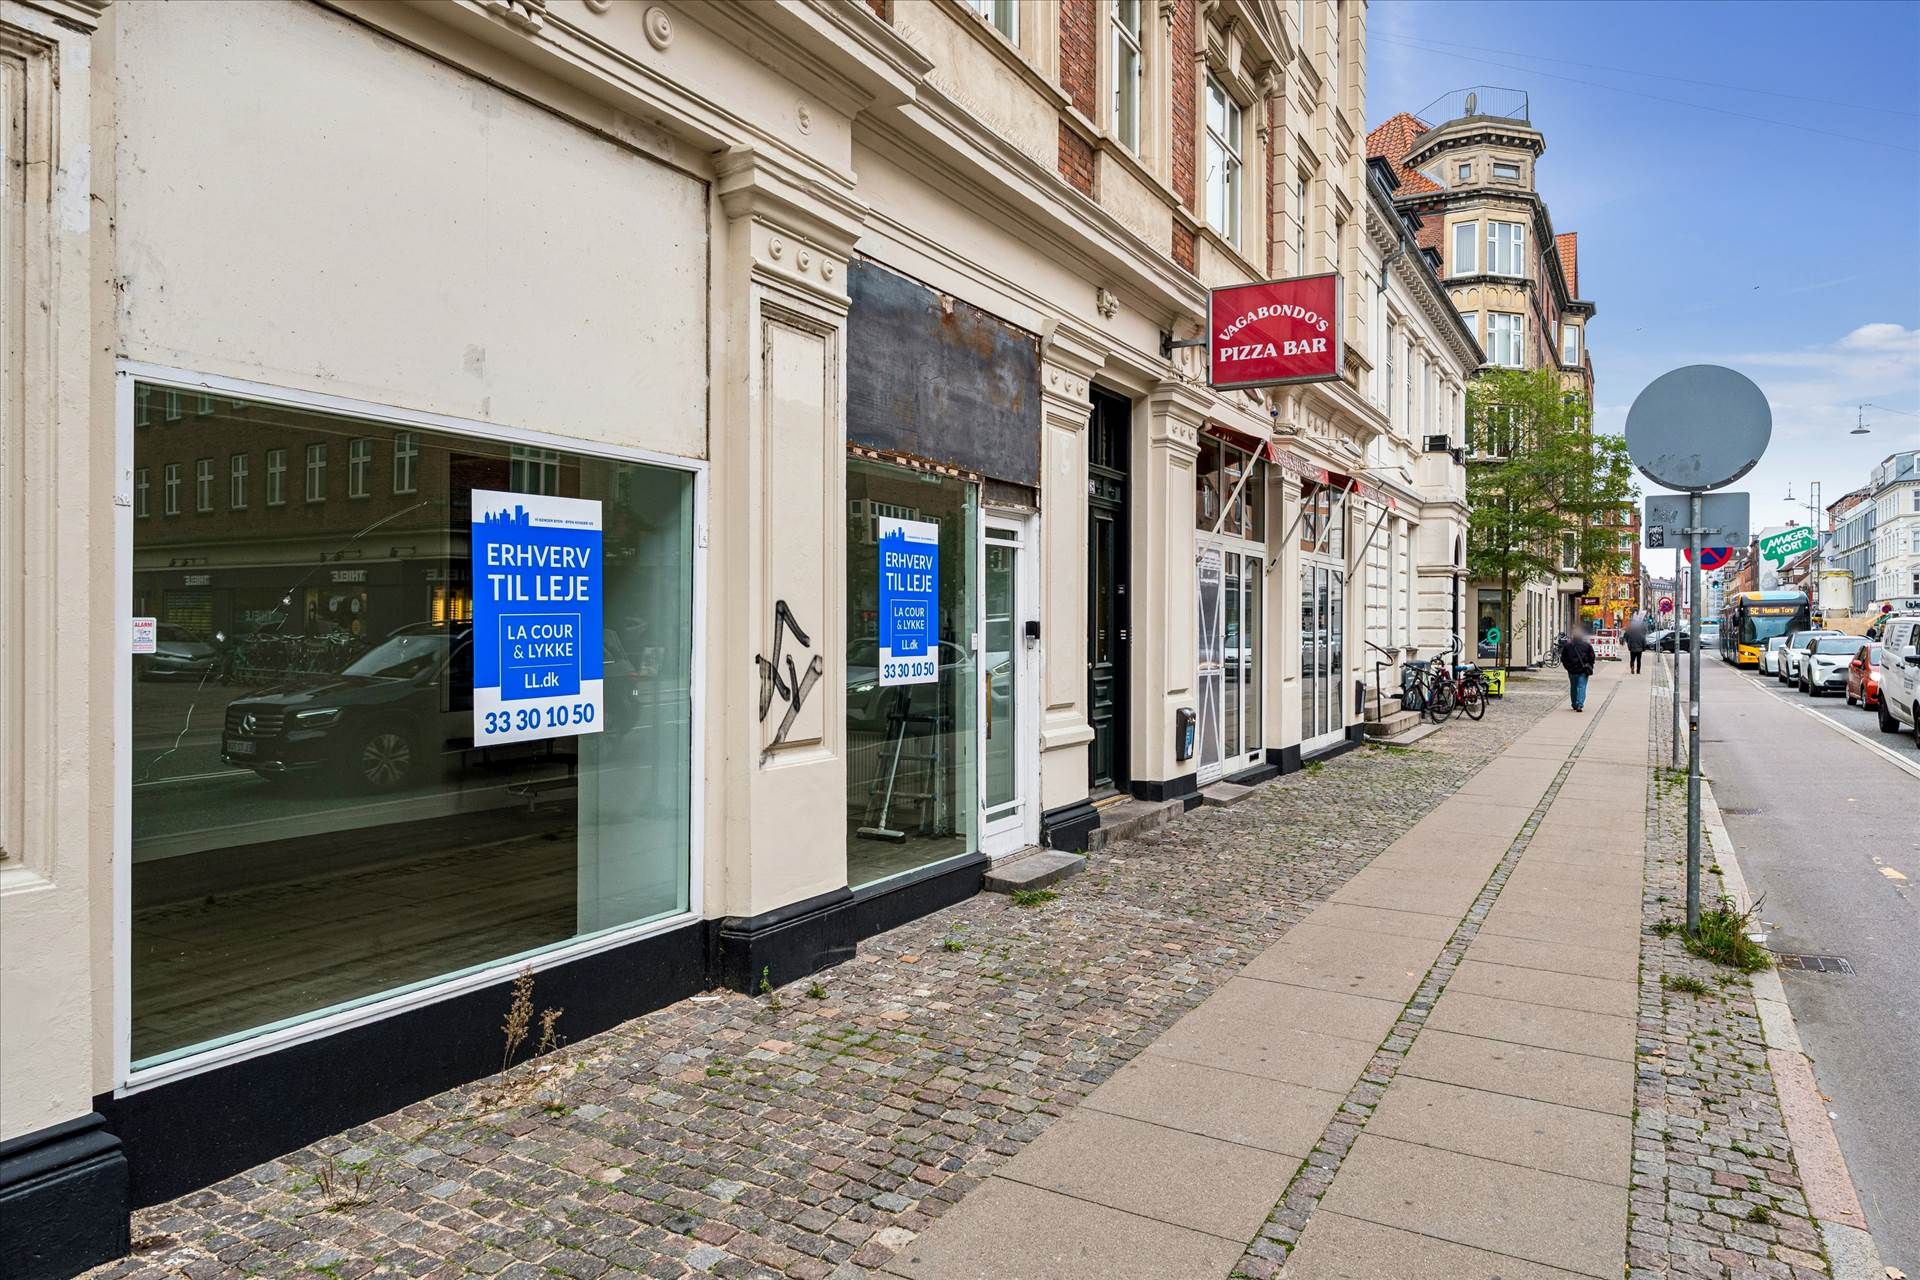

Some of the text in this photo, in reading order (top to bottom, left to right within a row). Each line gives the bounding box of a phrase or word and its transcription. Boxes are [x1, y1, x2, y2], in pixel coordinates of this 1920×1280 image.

[1220, 337, 1327, 362] PIZZA BAR
[1762, 528, 1818, 554] AMAGER
[1777, 540, 1802, 555] KORT
[487, 543, 591, 568] ERHVERV
[885, 552, 933, 570] ERHVERV
[488, 574, 589, 602] TIL LEJE
[886, 573, 932, 592] TIL LEJE
[894, 607, 925, 617] LA COUR
[508, 624, 573, 640] LA COUR
[896, 620, 925, 630] & LYKKE
[513, 642, 573, 659] & LYKKE
[884, 661, 934, 679] 33 30 10 50
[524, 671, 559, 689] LL.dk
[485, 703, 594, 734] 33 30 10 50
